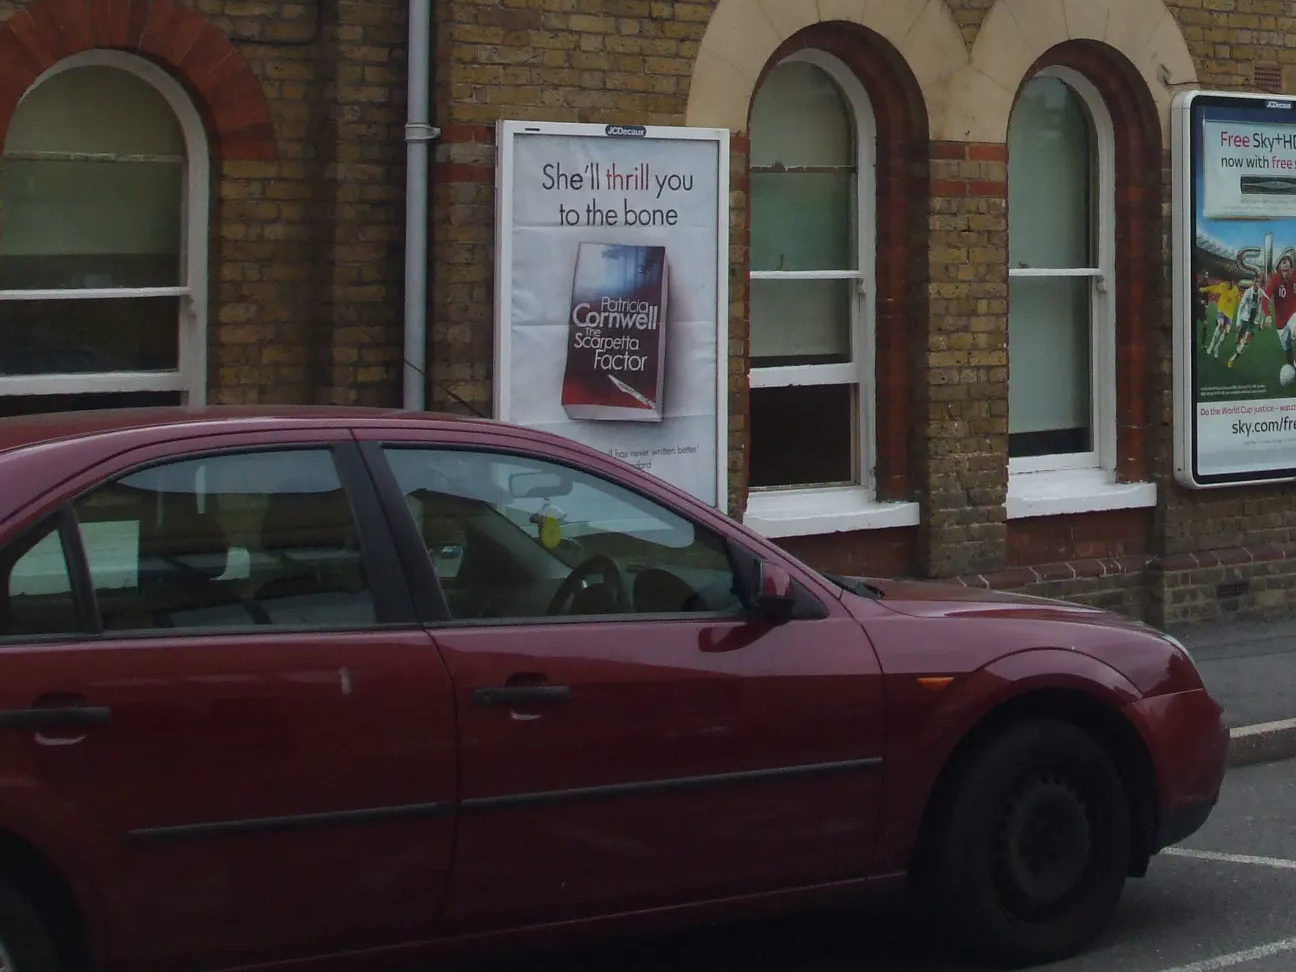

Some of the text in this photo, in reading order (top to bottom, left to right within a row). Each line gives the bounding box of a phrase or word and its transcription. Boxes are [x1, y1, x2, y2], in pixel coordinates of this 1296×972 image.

[607, 126, 645, 136] JCDecaux
[1220, 131, 1250, 148] Free
[1221, 158, 1244, 168] now
[1246, 155, 1270, 169] with
[1272, 156, 1292, 169] free
[542, 162, 693, 199] She'll thrill you
[559, 198, 678, 226] to the bone
[601, 296, 649, 314] Patricia
[572, 302, 659, 330] Cornwell
[585, 327, 601, 337] The
[574, 332, 640, 352] Scarpetta
[594, 349, 648, 371] Factor
[1200, 408, 1210, 416] Do
[1222, 406, 1240, 415] World
[1240, 405, 1253, 415] Cup
[1253, 404, 1274, 415] justice
[651, 447, 676, 456] written
